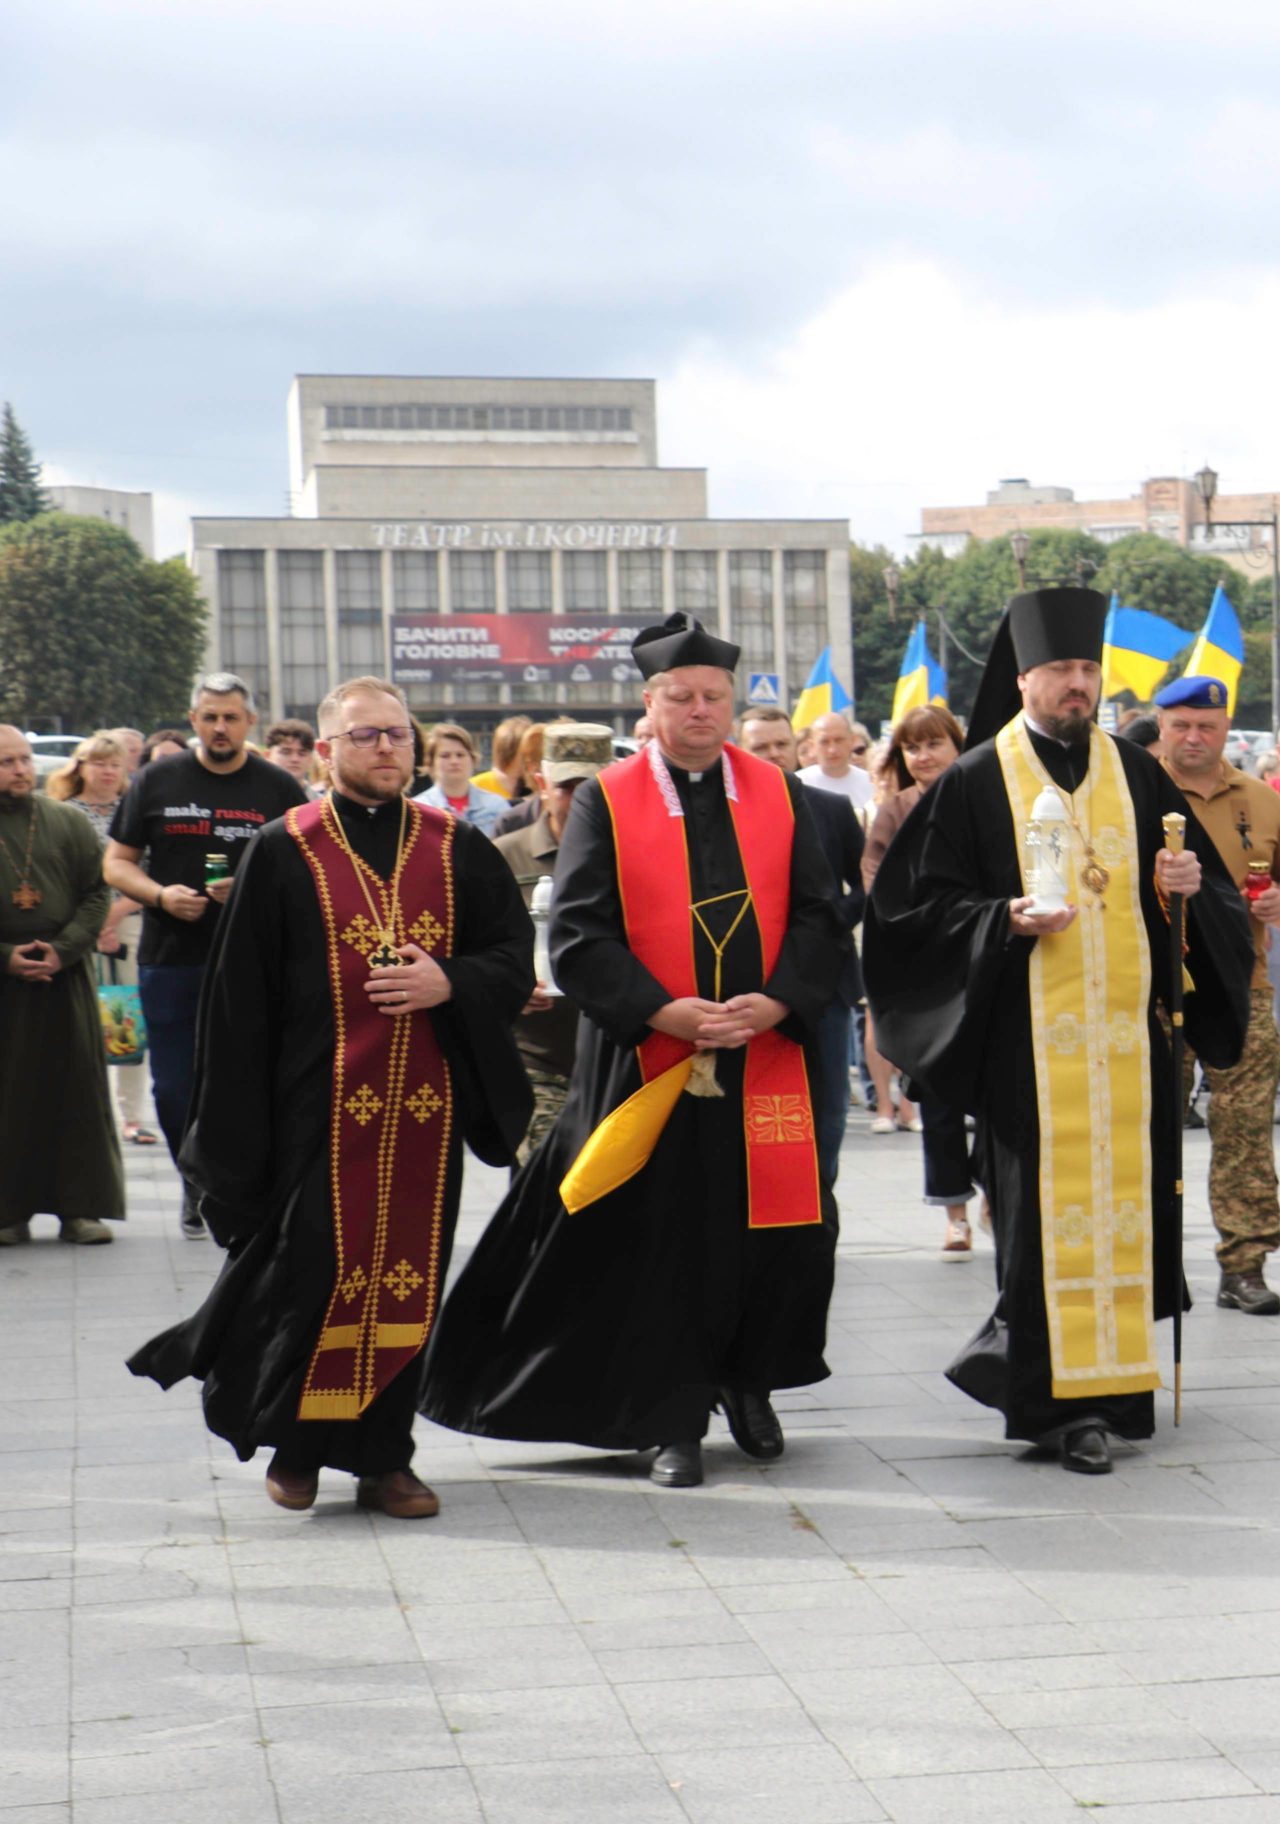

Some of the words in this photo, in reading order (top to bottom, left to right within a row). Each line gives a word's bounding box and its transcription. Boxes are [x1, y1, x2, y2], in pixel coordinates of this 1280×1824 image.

[371, 524, 471, 547] ТЕАТР
[394, 627, 488, 642] БАЧИТИ
[394, 643, 501, 660] ГОЛОВНЕ
[163, 802, 211, 818] make
[214, 807, 266, 824] russia
[163, 819, 211, 835] small
